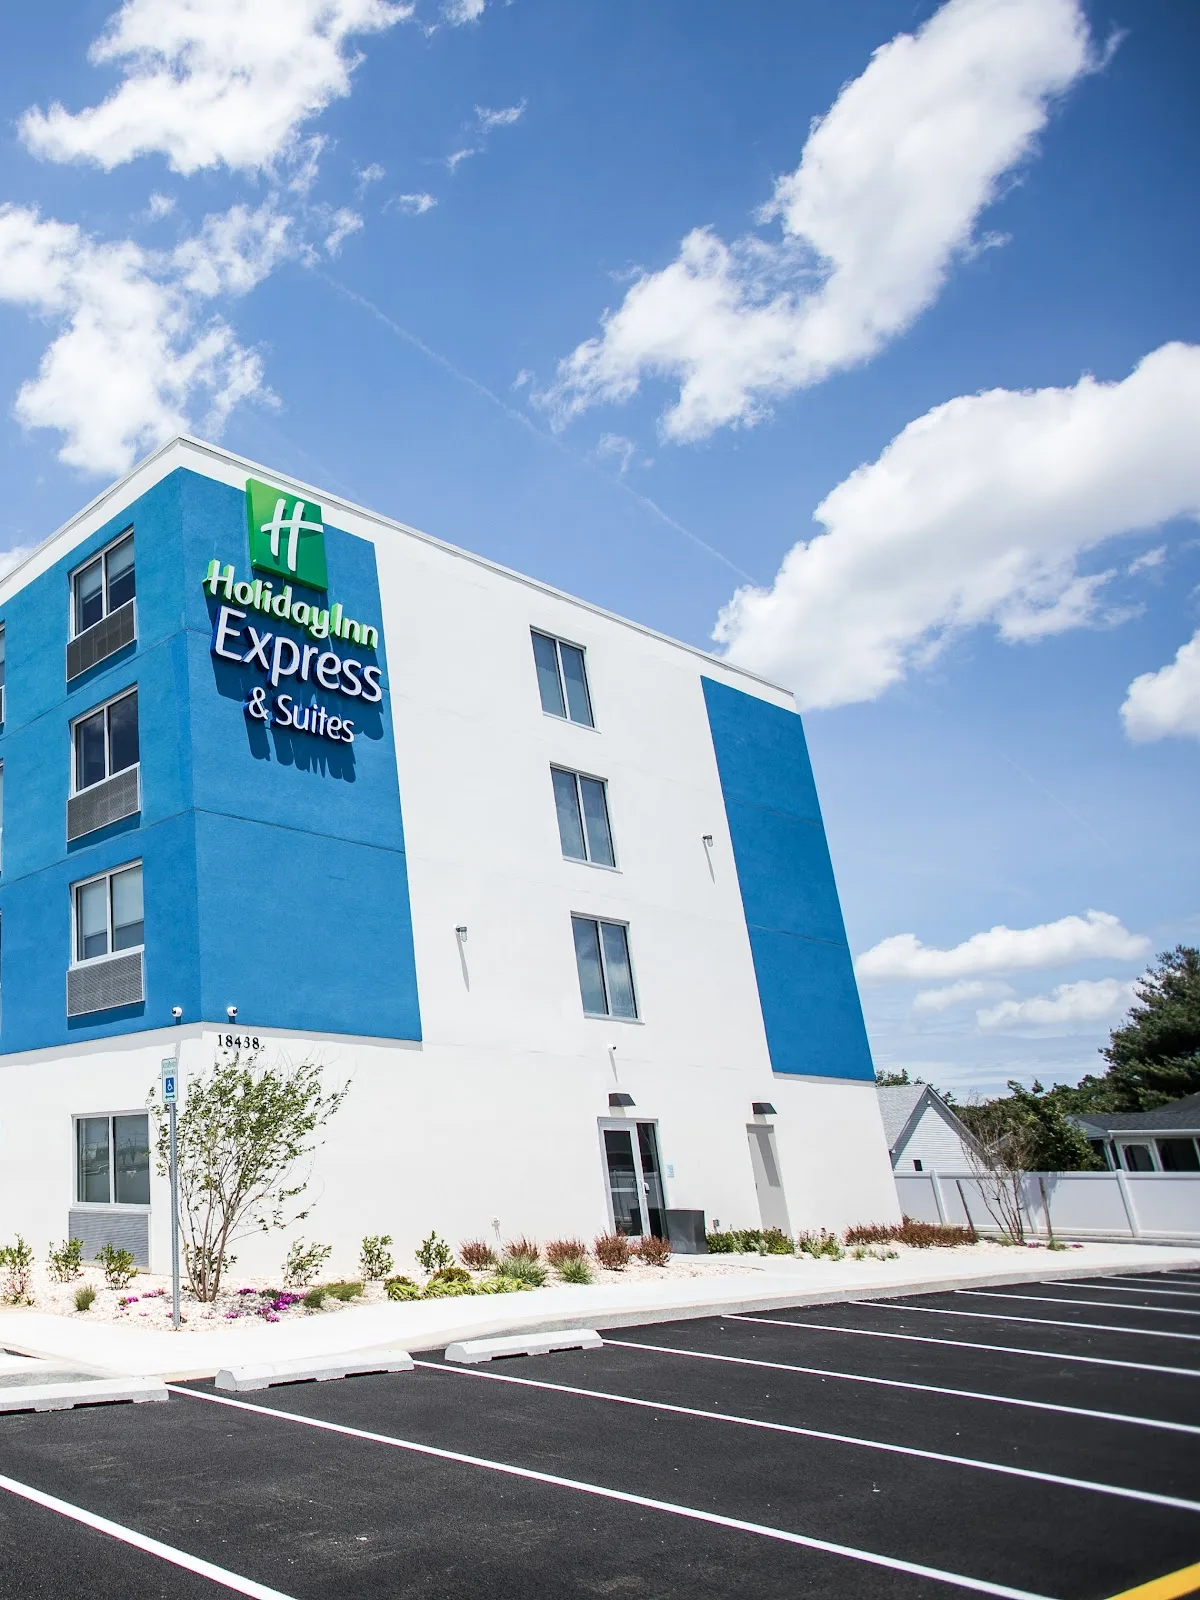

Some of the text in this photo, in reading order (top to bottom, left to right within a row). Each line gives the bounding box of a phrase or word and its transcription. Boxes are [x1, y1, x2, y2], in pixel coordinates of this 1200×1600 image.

[260, 498, 324, 572] H
[204, 559, 379, 650] Holiday Inn
[214, 605, 383, 702] Express
[248, 686, 355, 743] & Suites
[217, 1034, 260, 1049] 18438
